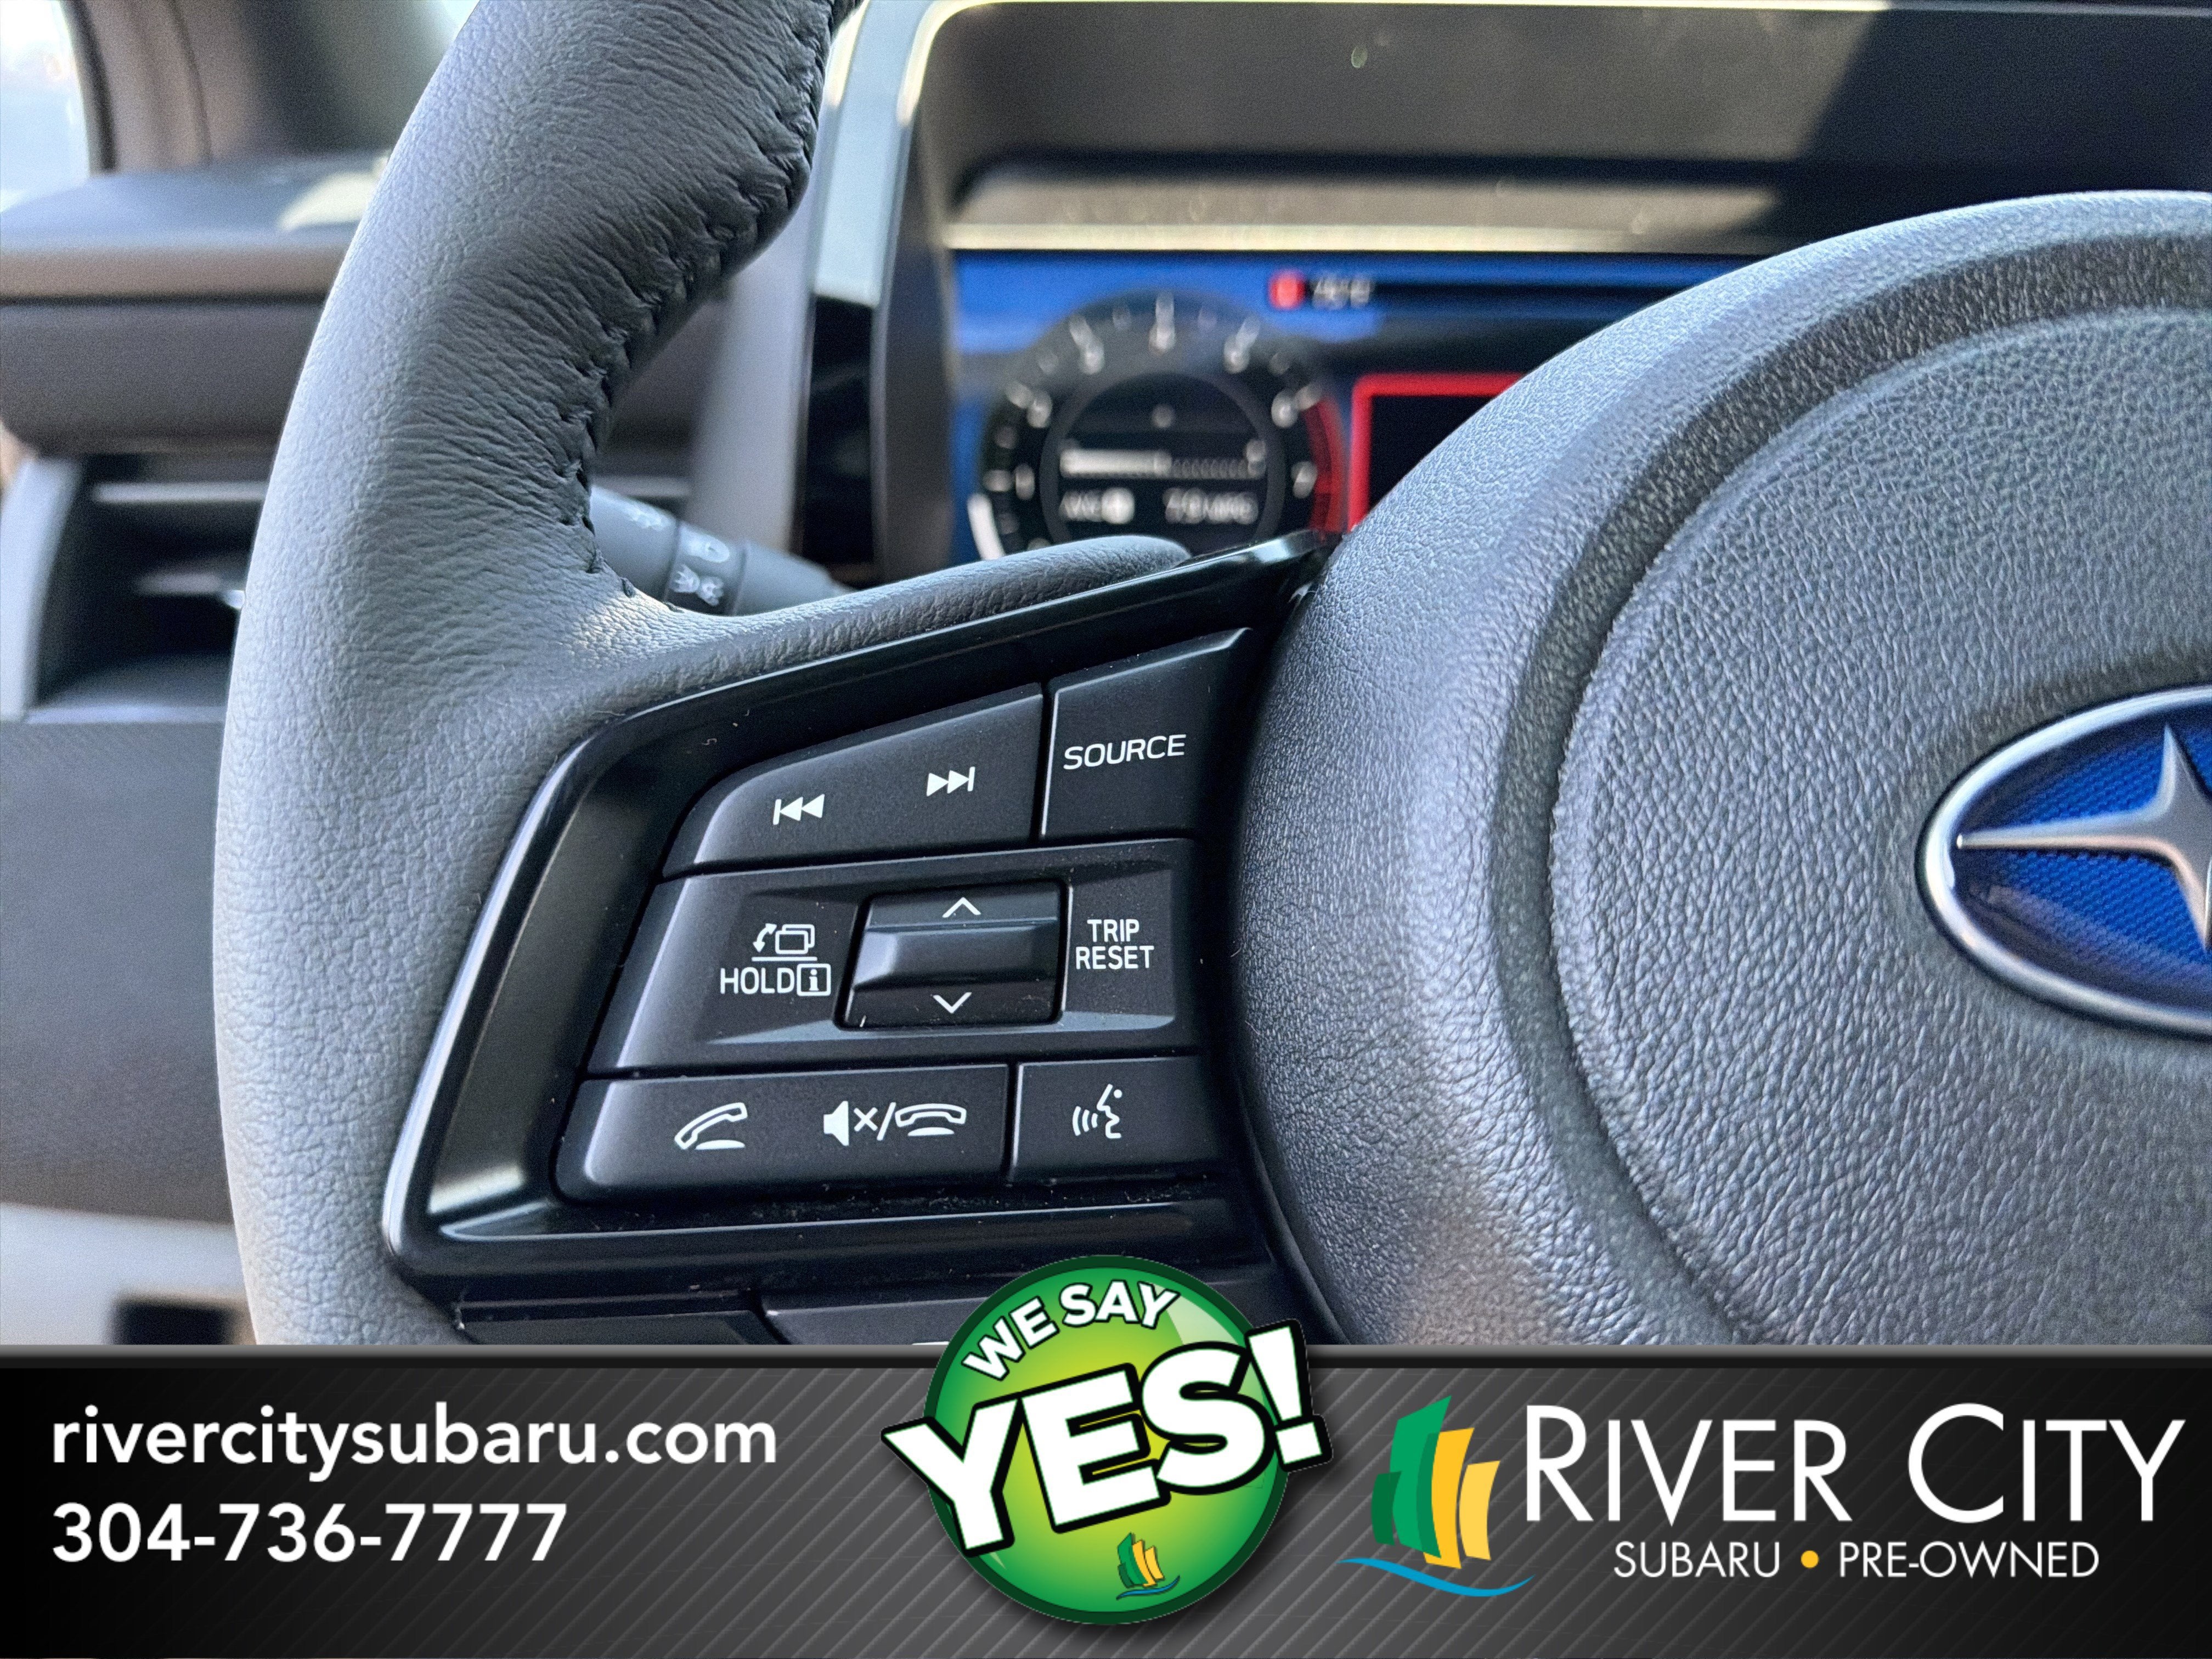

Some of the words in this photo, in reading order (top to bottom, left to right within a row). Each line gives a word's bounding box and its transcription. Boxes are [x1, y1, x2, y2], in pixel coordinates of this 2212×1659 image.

[1063, 733, 1187, 770] SOURCE
[1087, 918, 1140, 943] TRIP
[1075, 945, 1155, 970] RESET
[720, 967, 794, 995] HOLD
